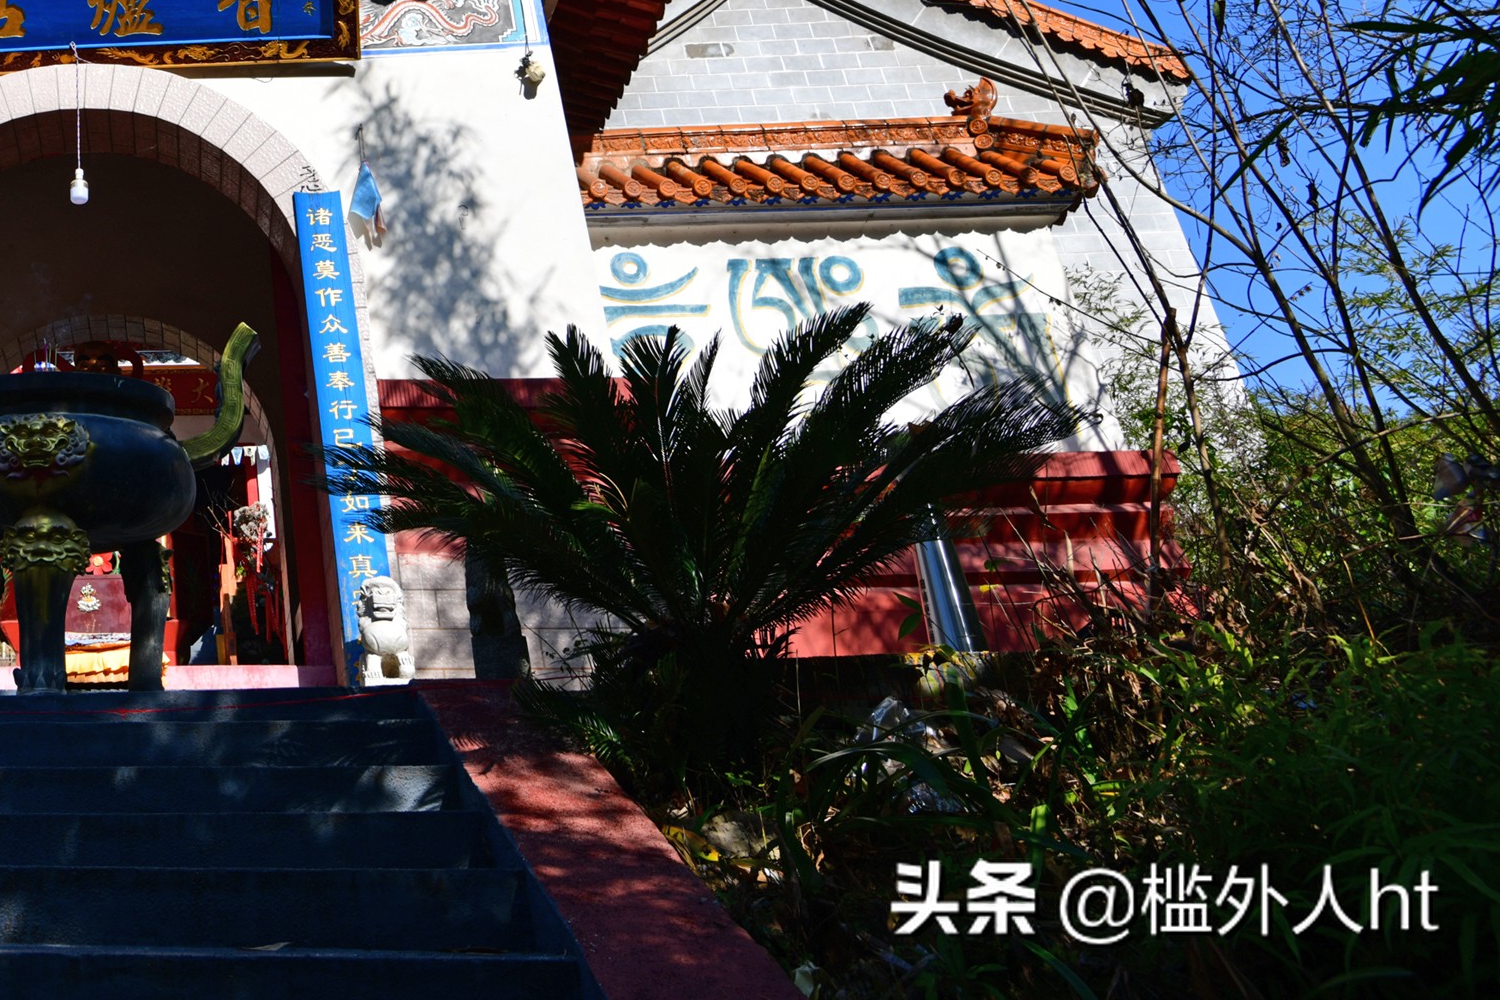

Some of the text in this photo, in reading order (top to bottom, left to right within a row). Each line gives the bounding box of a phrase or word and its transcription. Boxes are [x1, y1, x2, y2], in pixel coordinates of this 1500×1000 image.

[305, 207, 378, 607] 诸恶莫作众善奉行已如来真
